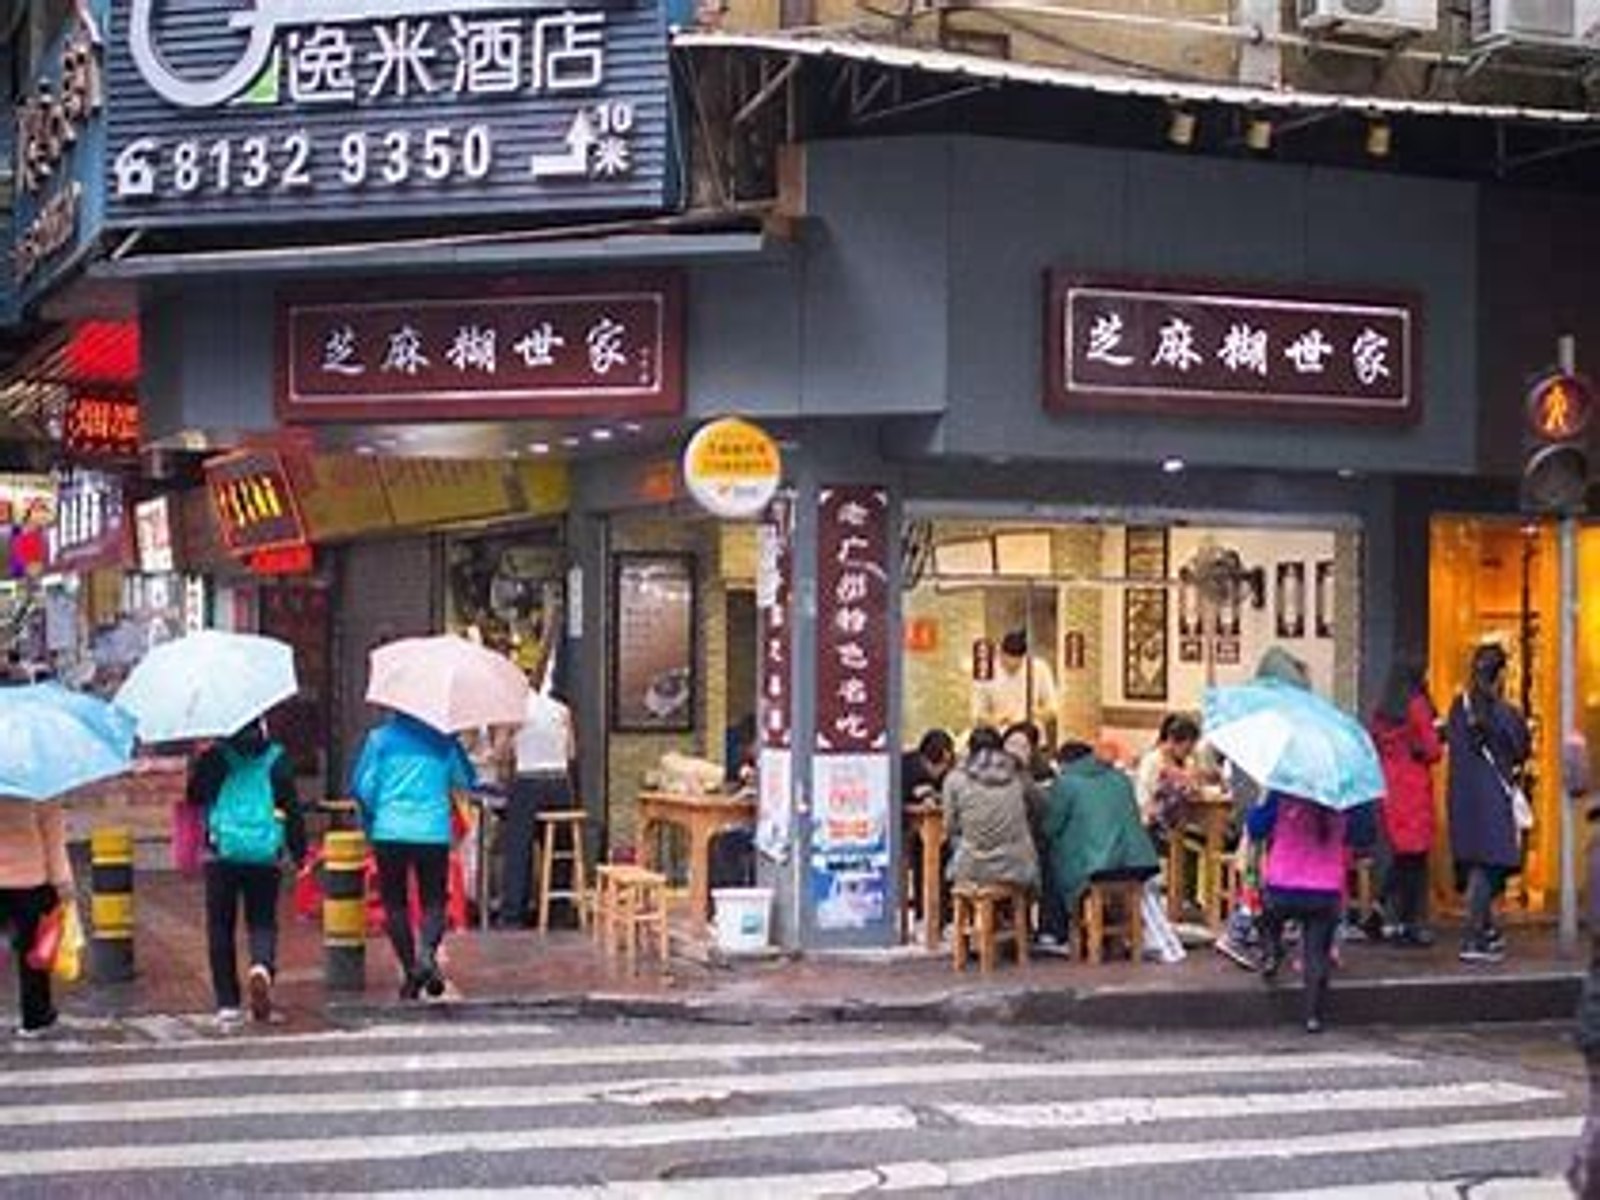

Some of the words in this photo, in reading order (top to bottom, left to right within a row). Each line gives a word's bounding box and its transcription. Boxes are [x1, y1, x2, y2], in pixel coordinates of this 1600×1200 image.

[288, 13, 606, 101] 逸米酒店
[595, 104, 632, 133] 10
[174, 130, 310, 192] 8132
[340, 124, 490, 185] 9350
[595, 140, 629, 174] 米
[322, 318, 628, 375] 芝麻糊世家
[1086, 313, 1391, 386] 芝麻糊世家
